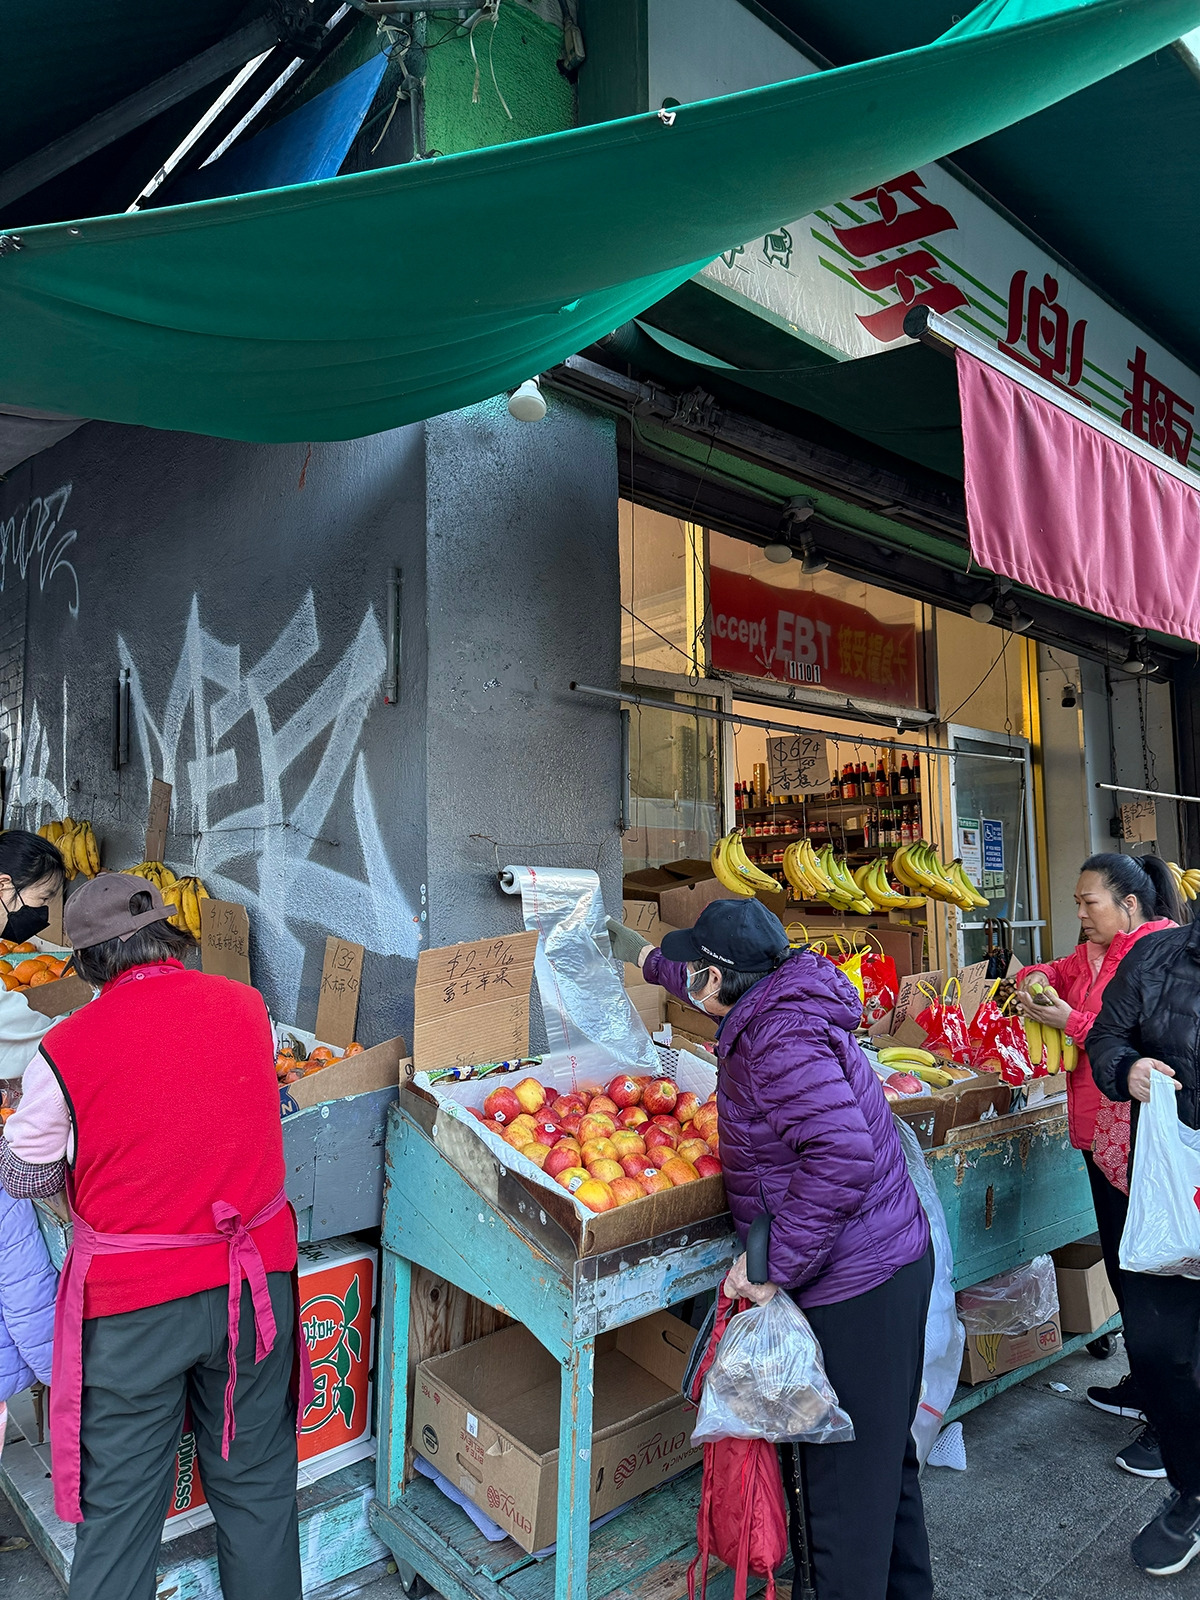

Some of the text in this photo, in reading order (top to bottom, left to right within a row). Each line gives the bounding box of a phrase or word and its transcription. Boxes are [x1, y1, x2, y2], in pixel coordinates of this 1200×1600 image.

[775, 610, 831, 669] EBT
[789, 661, 821, 683] 1101
[1039, 1330, 1057, 1346] Dole
[459, 1430, 485, 1457] BELIEVE
[637, 1431, 686, 1471] envy
[174, 1432, 198, 1510] ppiness
[499, 1494, 533, 1535] envy
